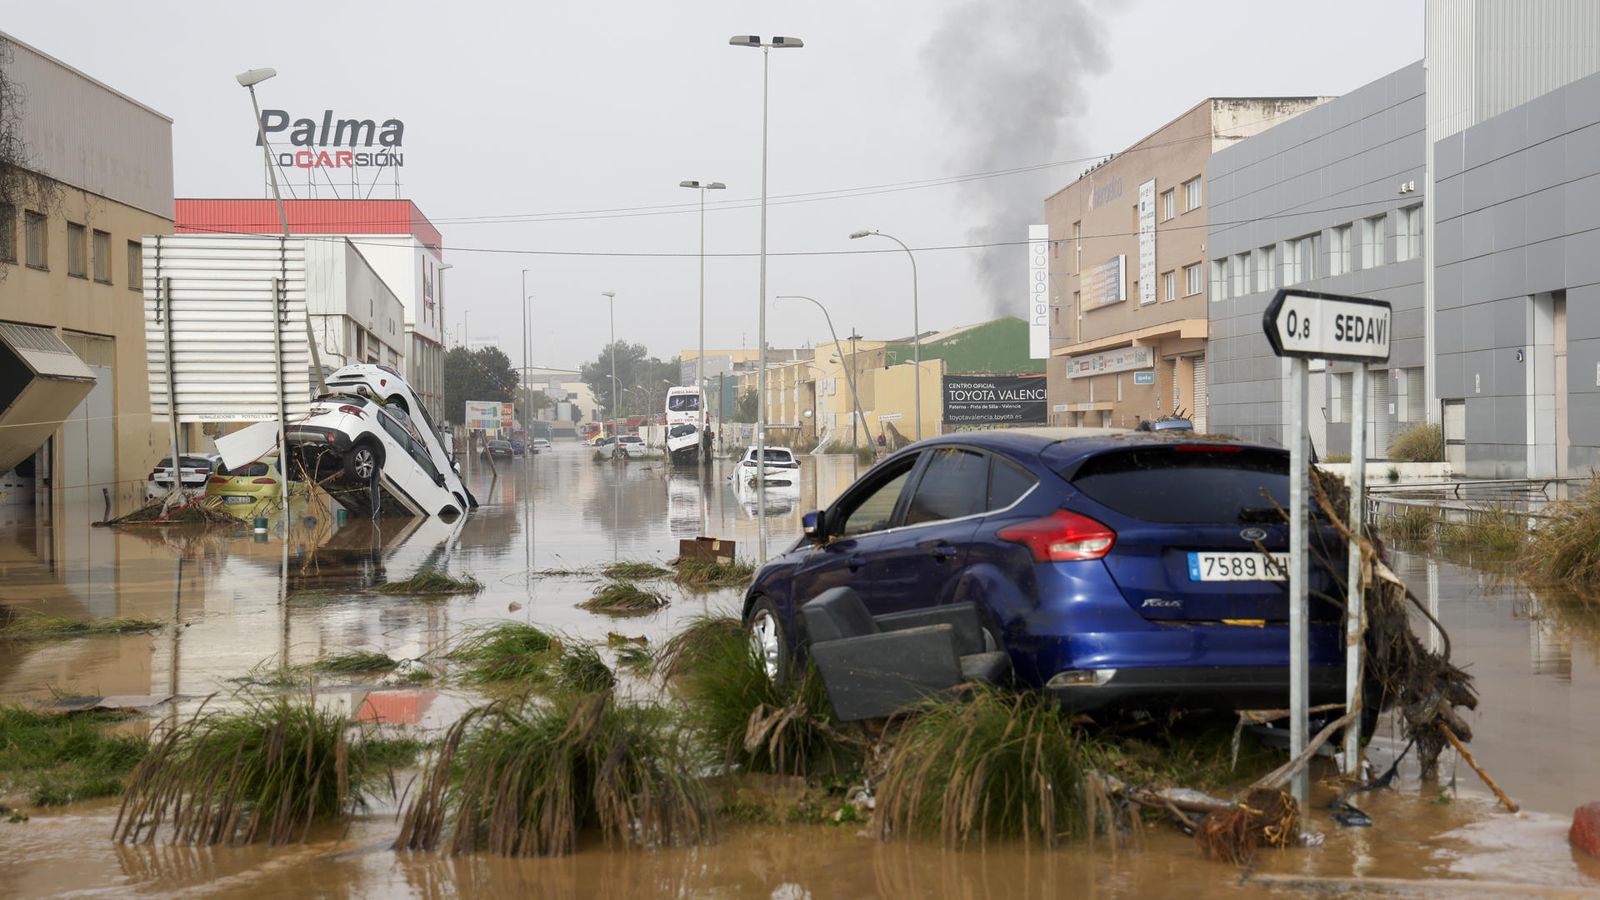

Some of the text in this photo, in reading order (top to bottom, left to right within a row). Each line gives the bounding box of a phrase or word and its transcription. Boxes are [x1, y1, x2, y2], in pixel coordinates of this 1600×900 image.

[256, 109, 404, 147] Palma
[1287, 309, 1387, 345] 0,8 SEDAVÍ
[949, 390, 996, 401] TOYOTA
[1204, 556, 1290, 577] 7589 KH
